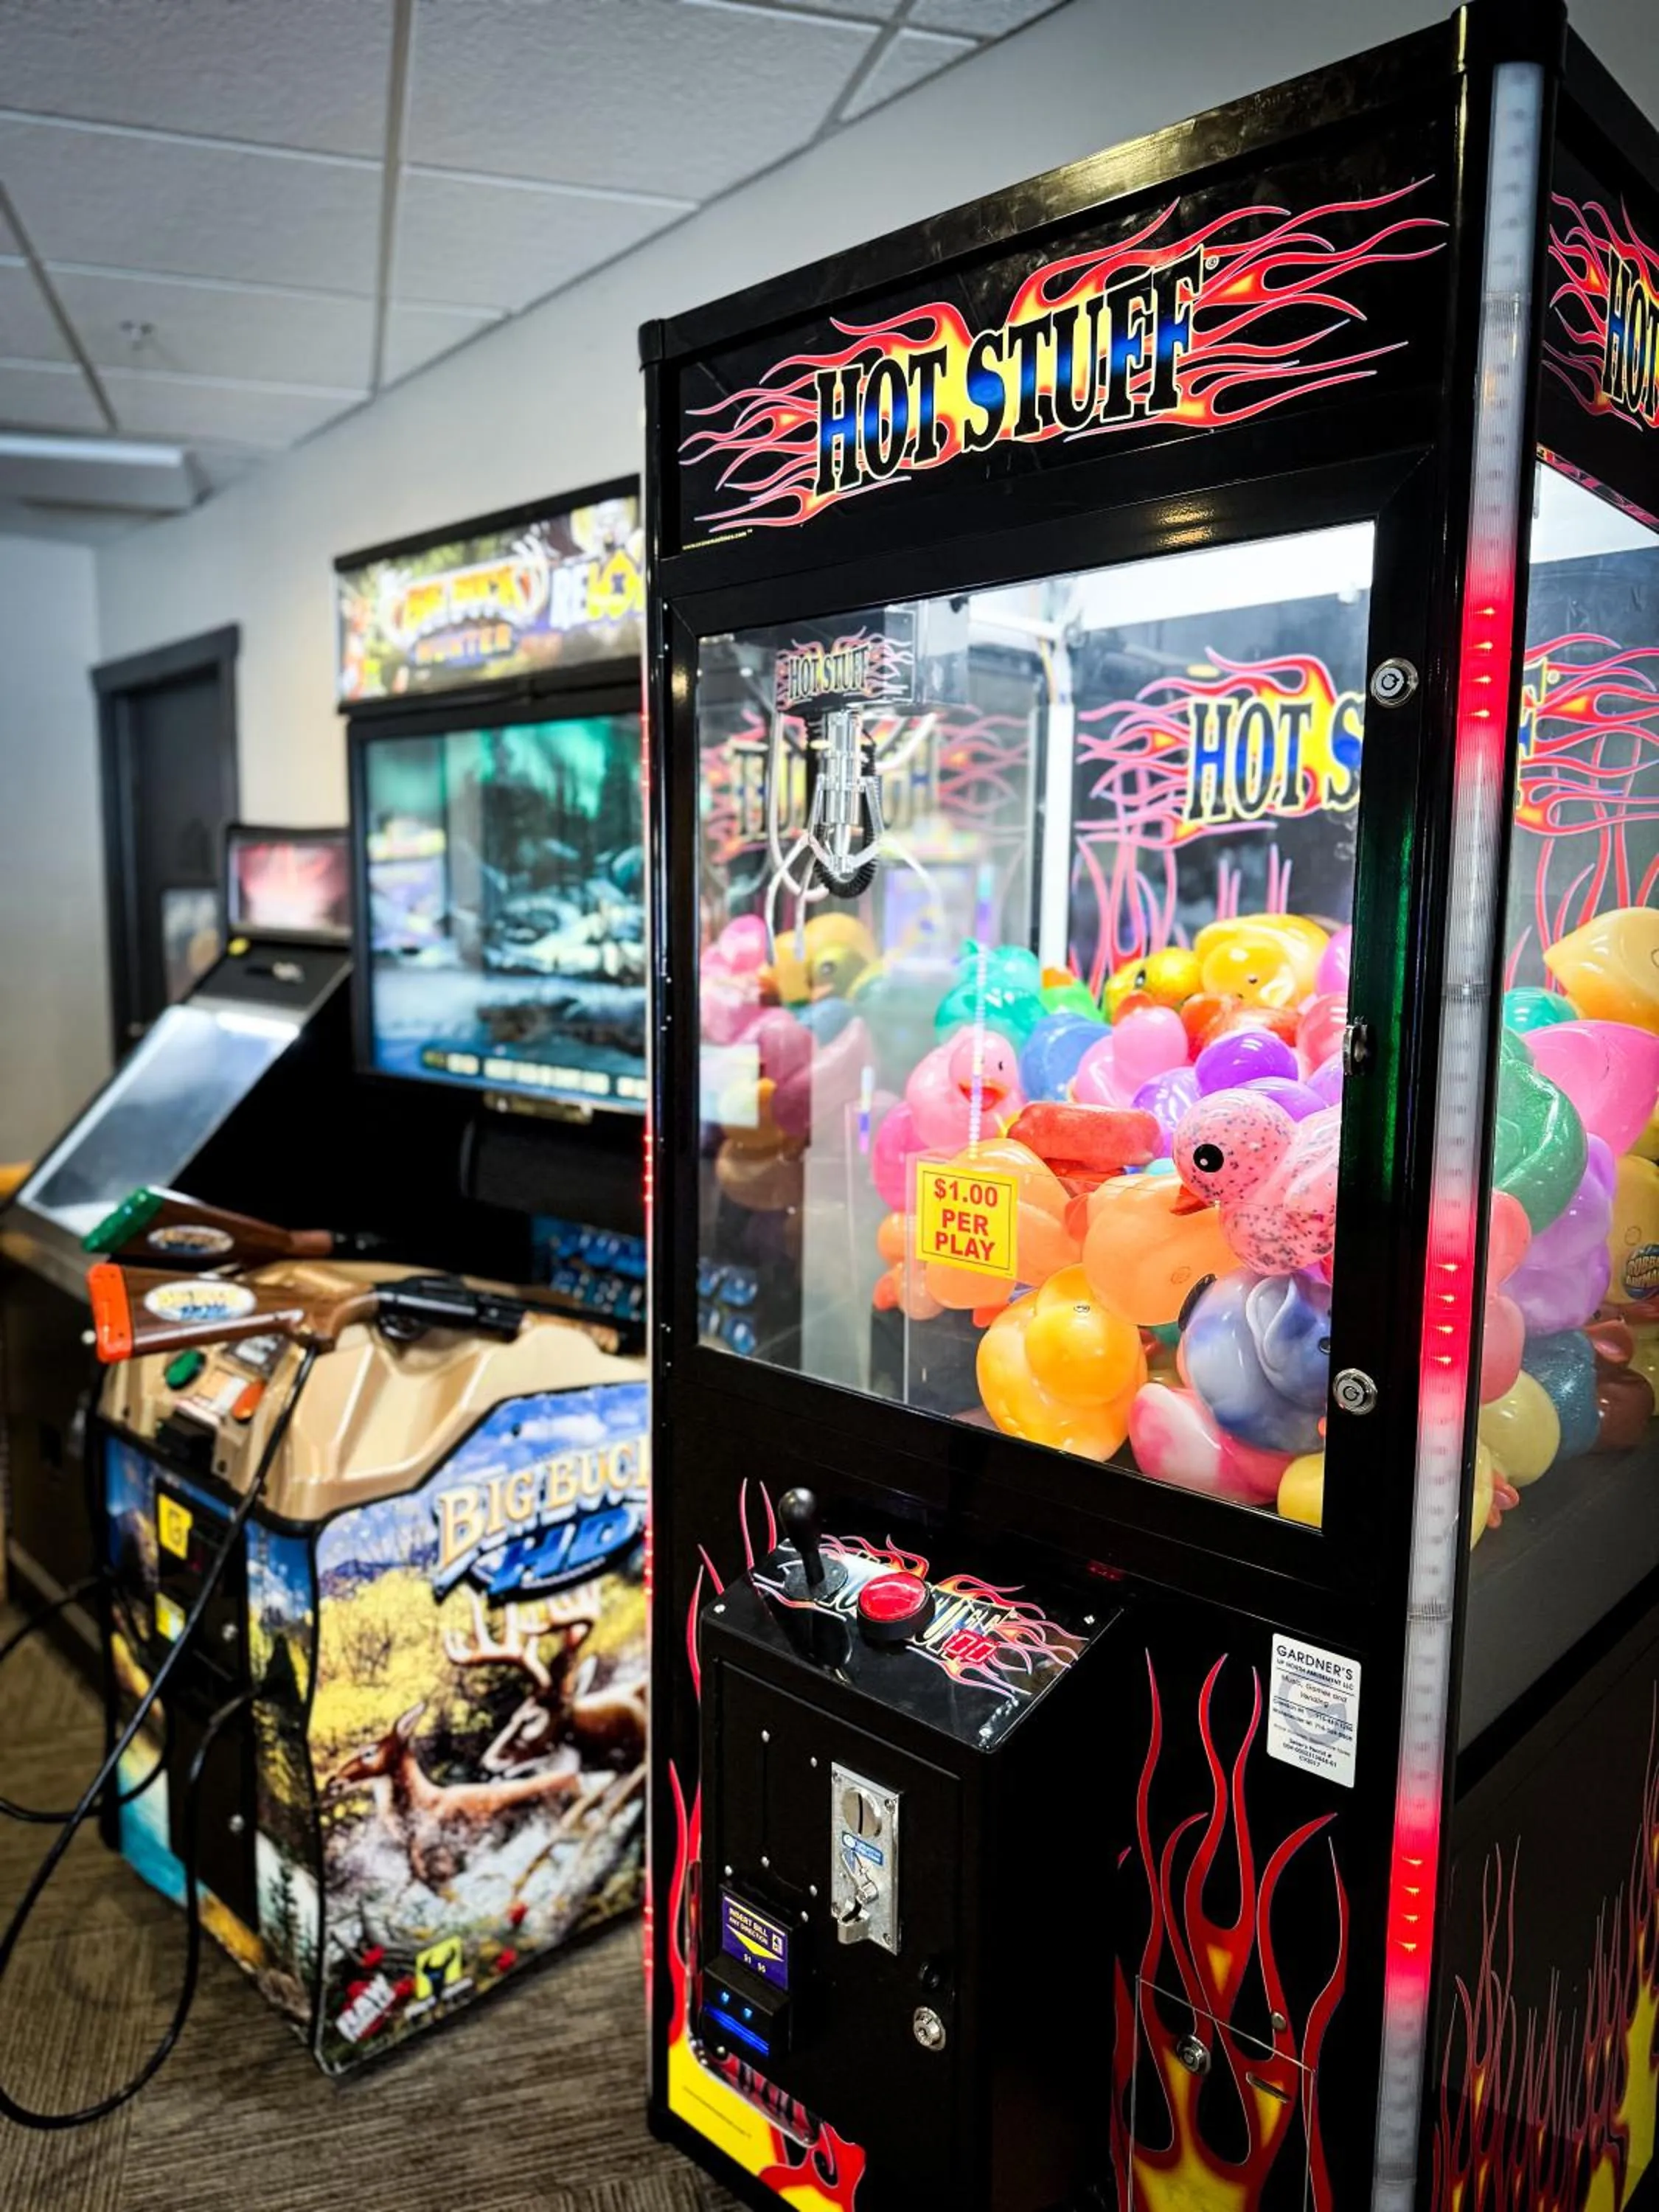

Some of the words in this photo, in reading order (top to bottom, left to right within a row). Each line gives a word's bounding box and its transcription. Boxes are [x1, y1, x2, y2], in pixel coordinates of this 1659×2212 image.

[814, 344, 949, 497] HOT
[961, 245, 1205, 451] STUFF
[787, 655, 820, 700] HOT
[822, 643, 871, 693] STUFF
[1183, 696, 1317, 825] HOT
[933, 1178, 998, 1208] $1.00
[942, 1208, 989, 1237] PER
[935, 1231, 995, 1261] PLAY
[439, 1471, 536, 1568] BIG
[1276, 1644, 1354, 1680] GARDNER'S
